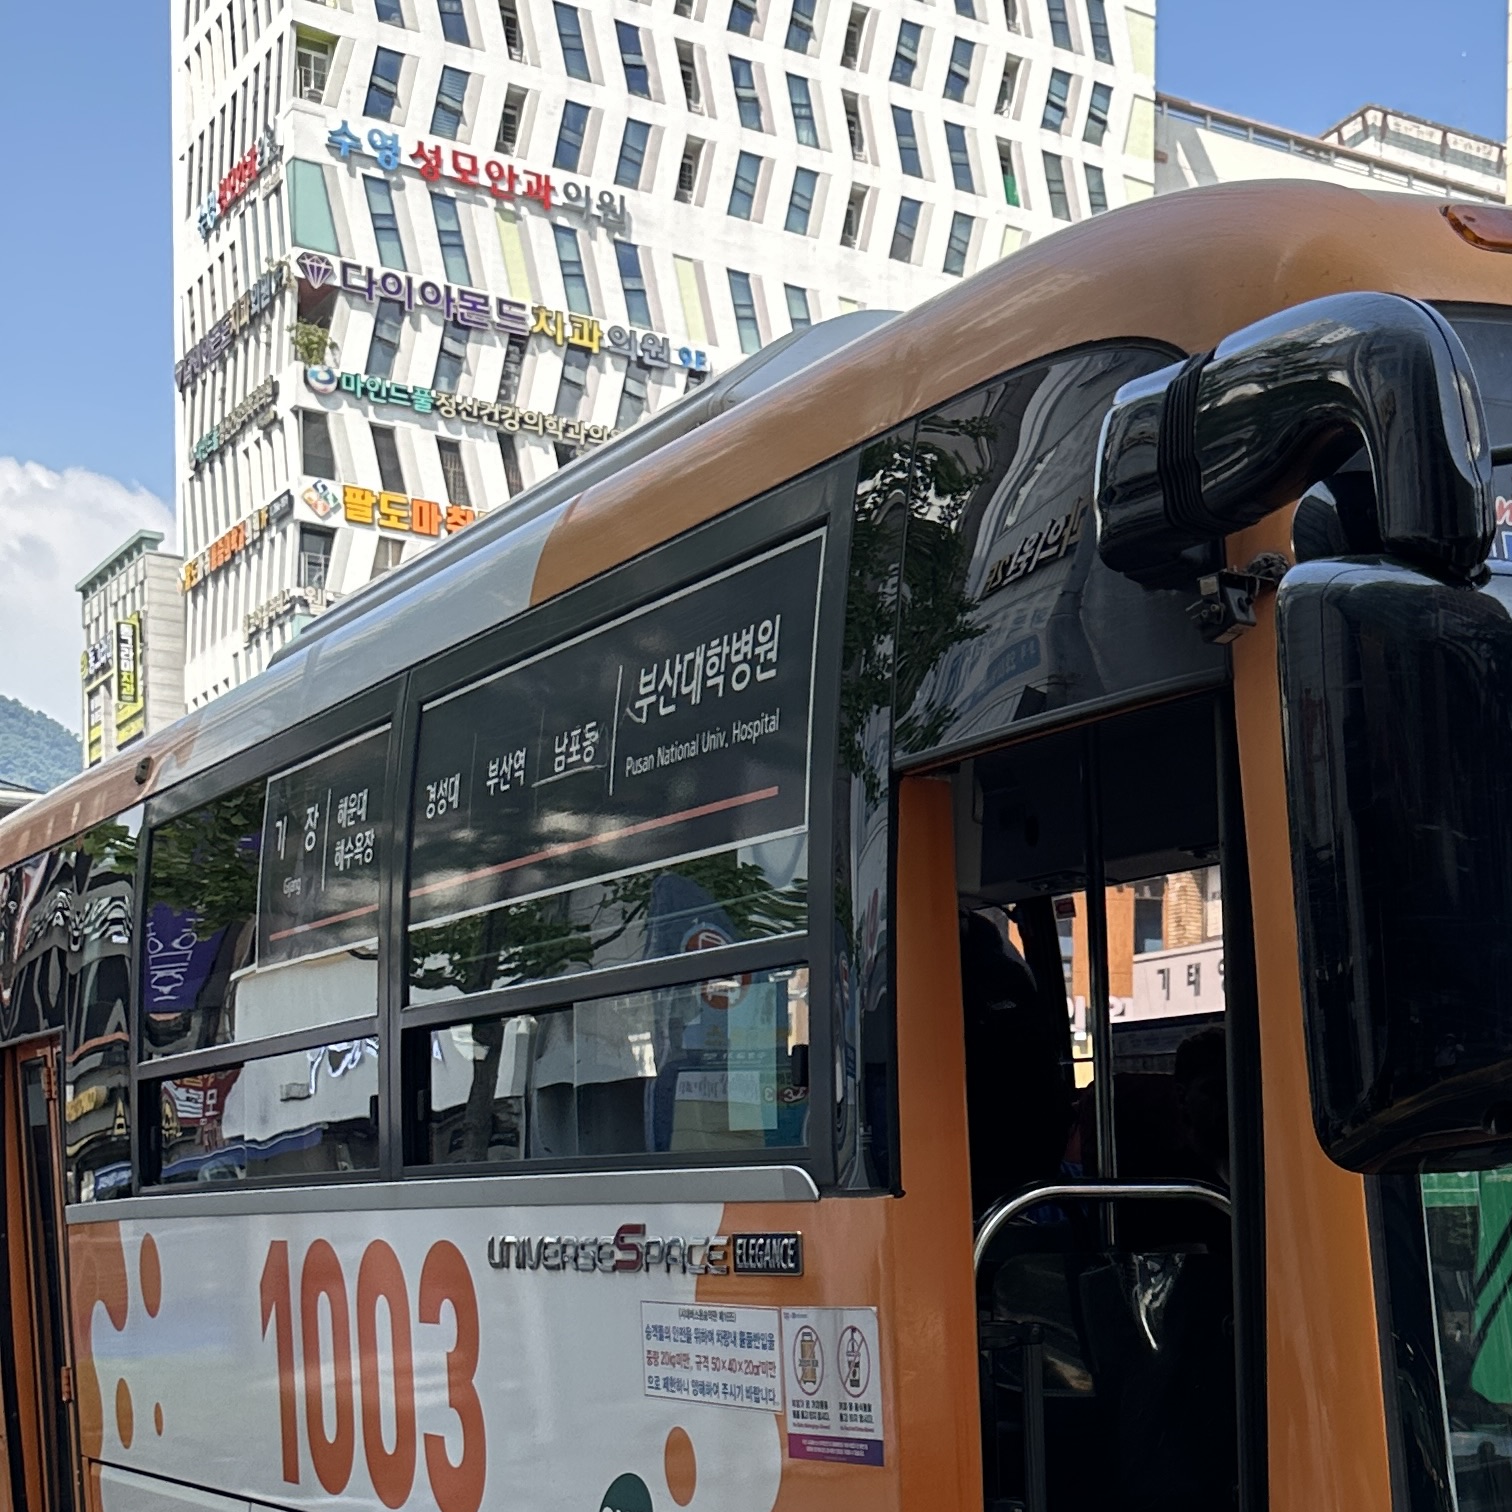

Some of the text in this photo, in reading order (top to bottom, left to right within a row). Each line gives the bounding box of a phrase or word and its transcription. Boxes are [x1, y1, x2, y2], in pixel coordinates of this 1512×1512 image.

[327, 120, 628, 226] 수영 성모안과 의원
[340, 373, 624, 446] 마인드풀정신건강의학과의
[633, 613, 782, 724] 부산대학병원
[425, 720, 601, 820] 경성대 부산역 남포동
[625, 707, 780, 778] Pusan National Univ. Hospital
[336, 787, 369, 829] 해운대
[333, 827, 376, 872] 해수욕장
[735, 1237, 797, 1270] ELEGANCE
